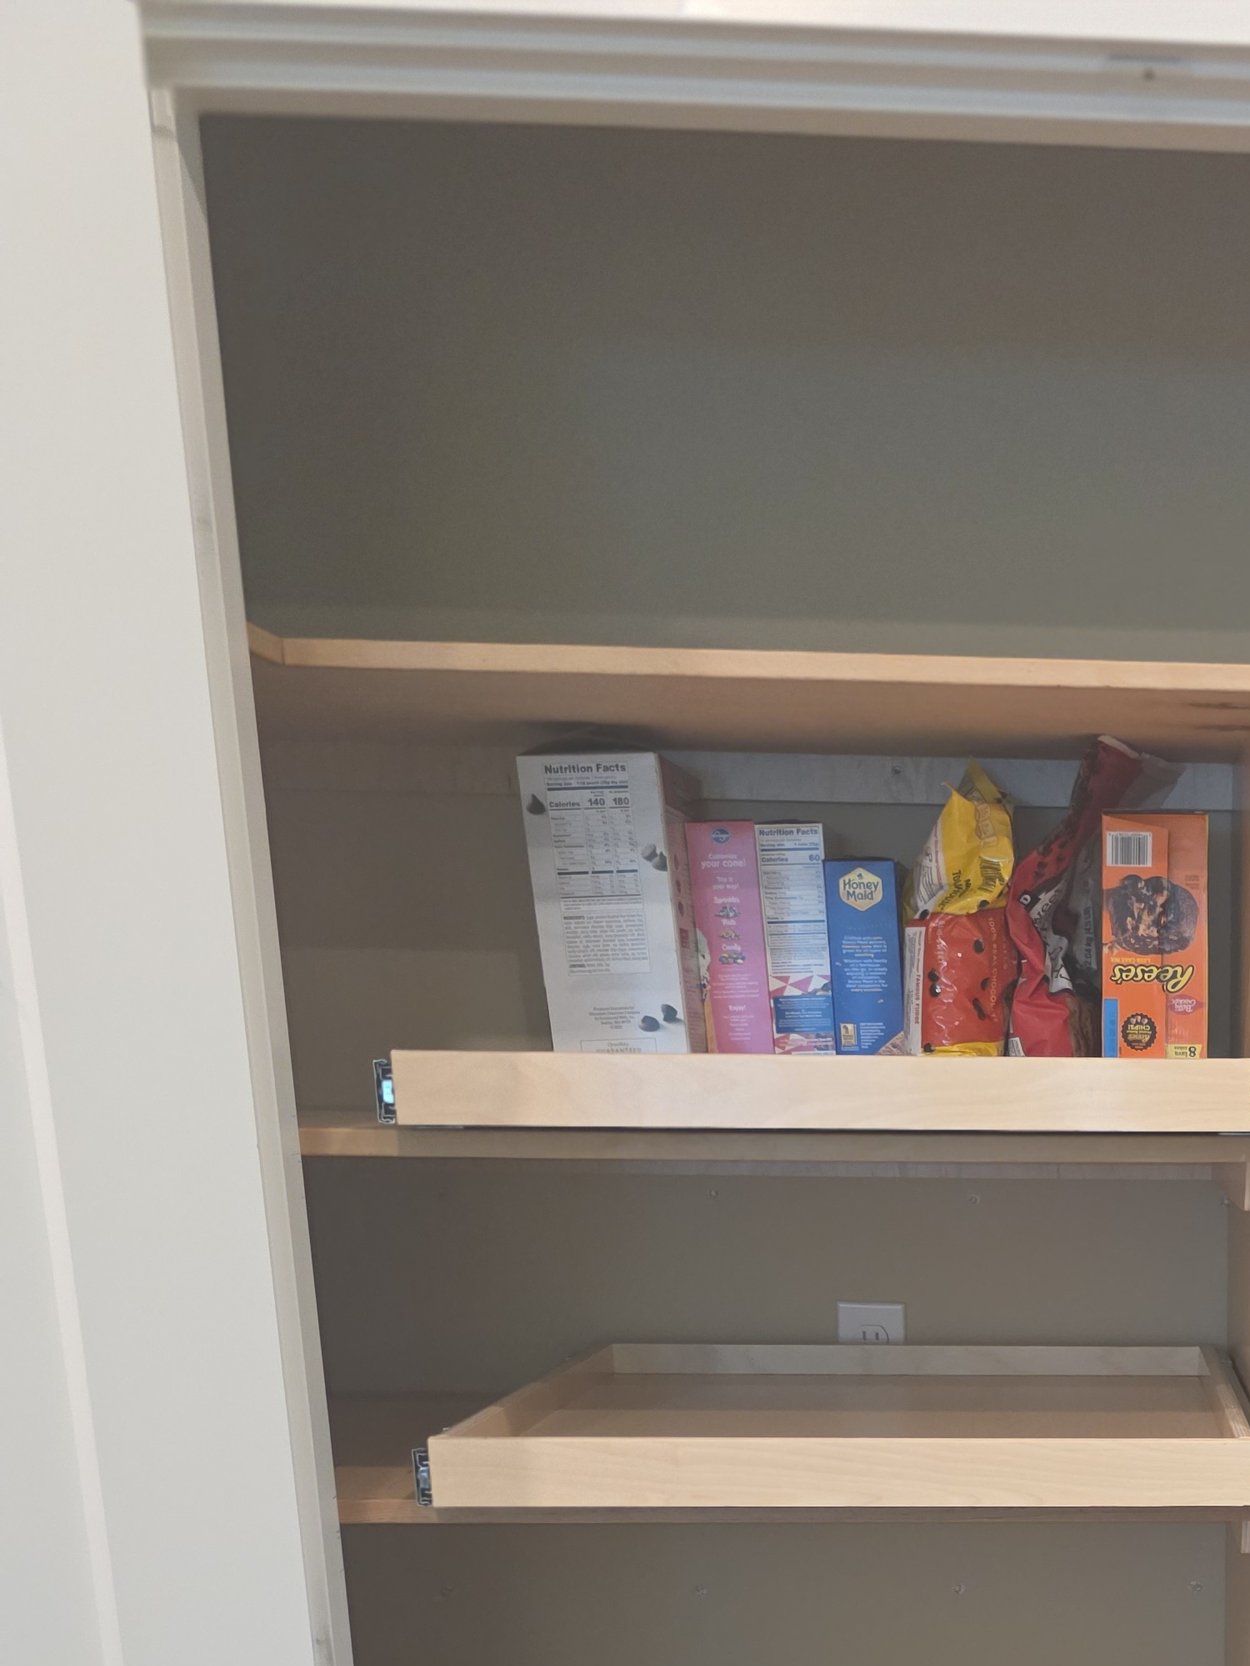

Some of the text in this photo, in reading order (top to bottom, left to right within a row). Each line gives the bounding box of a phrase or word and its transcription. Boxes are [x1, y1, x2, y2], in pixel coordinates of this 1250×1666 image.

[544, 763, 627, 775] Nutrition Facts
[588, 798, 606, 807] 140
[759, 828, 818, 837] Nutrition Facts
[842, 878, 881, 892] Honey
[846, 889, 874, 902] Maid
[1110, 964, 1194, 993] Reese's
[1187, 1046, 1197, 1058] 8
